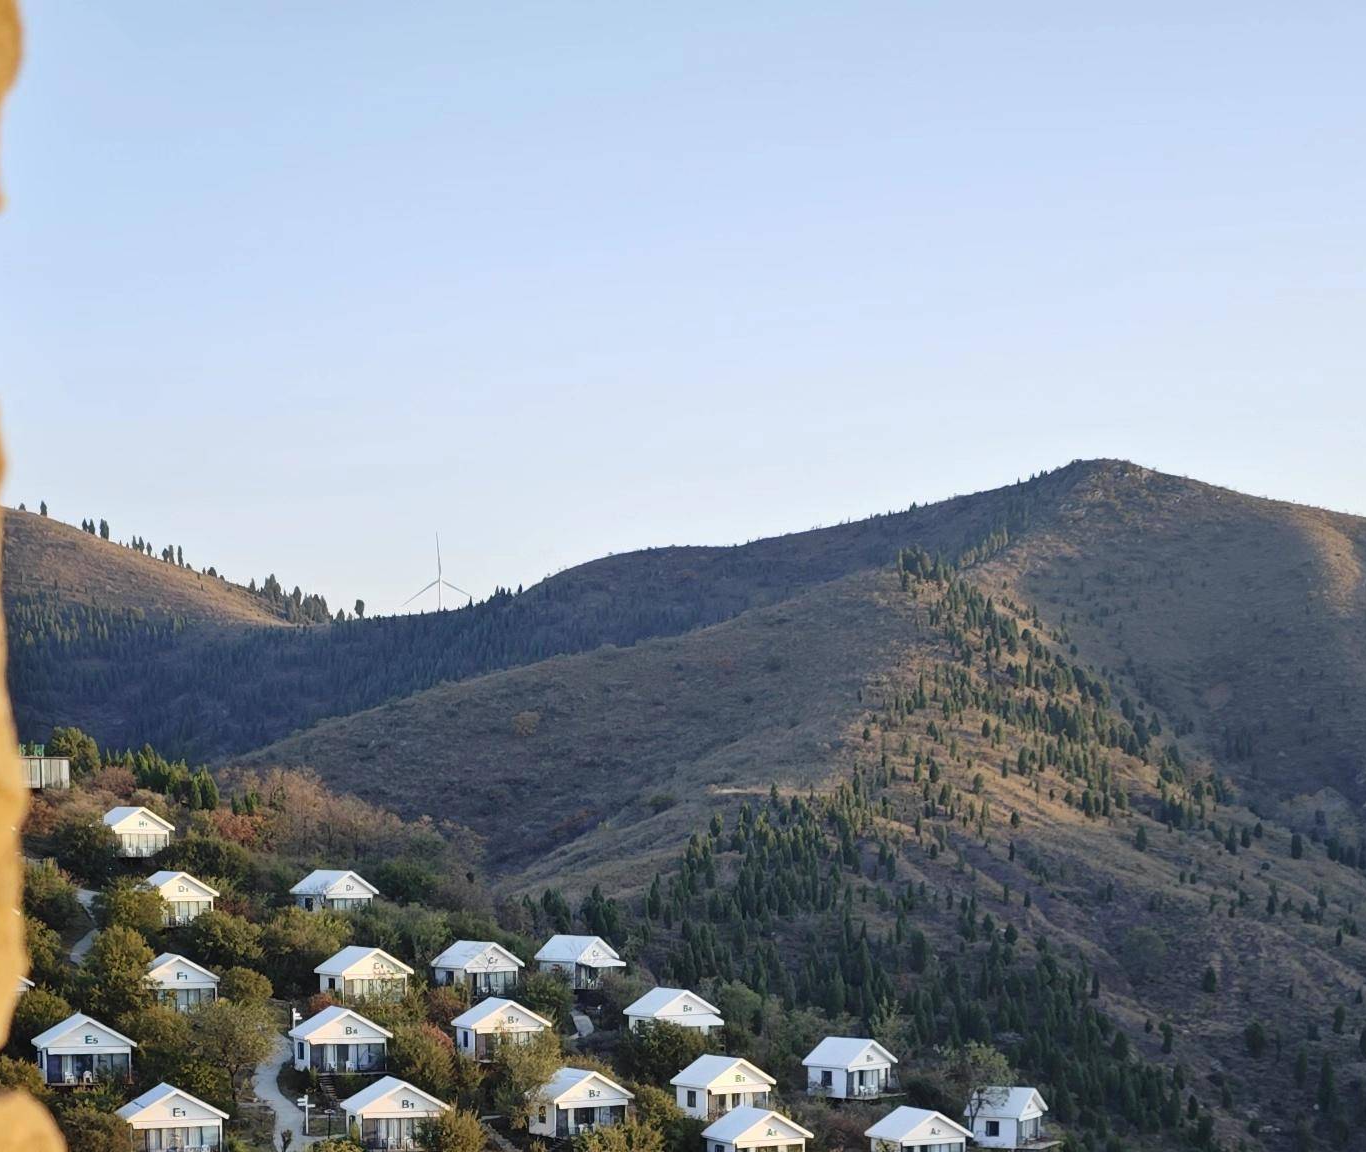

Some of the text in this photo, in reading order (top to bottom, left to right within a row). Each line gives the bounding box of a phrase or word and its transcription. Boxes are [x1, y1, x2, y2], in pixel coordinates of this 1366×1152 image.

[85, 1035, 98, 1044] E5
[402, 1099, 414, 1109] B1
[172, 1107, 186, 1117] E1
